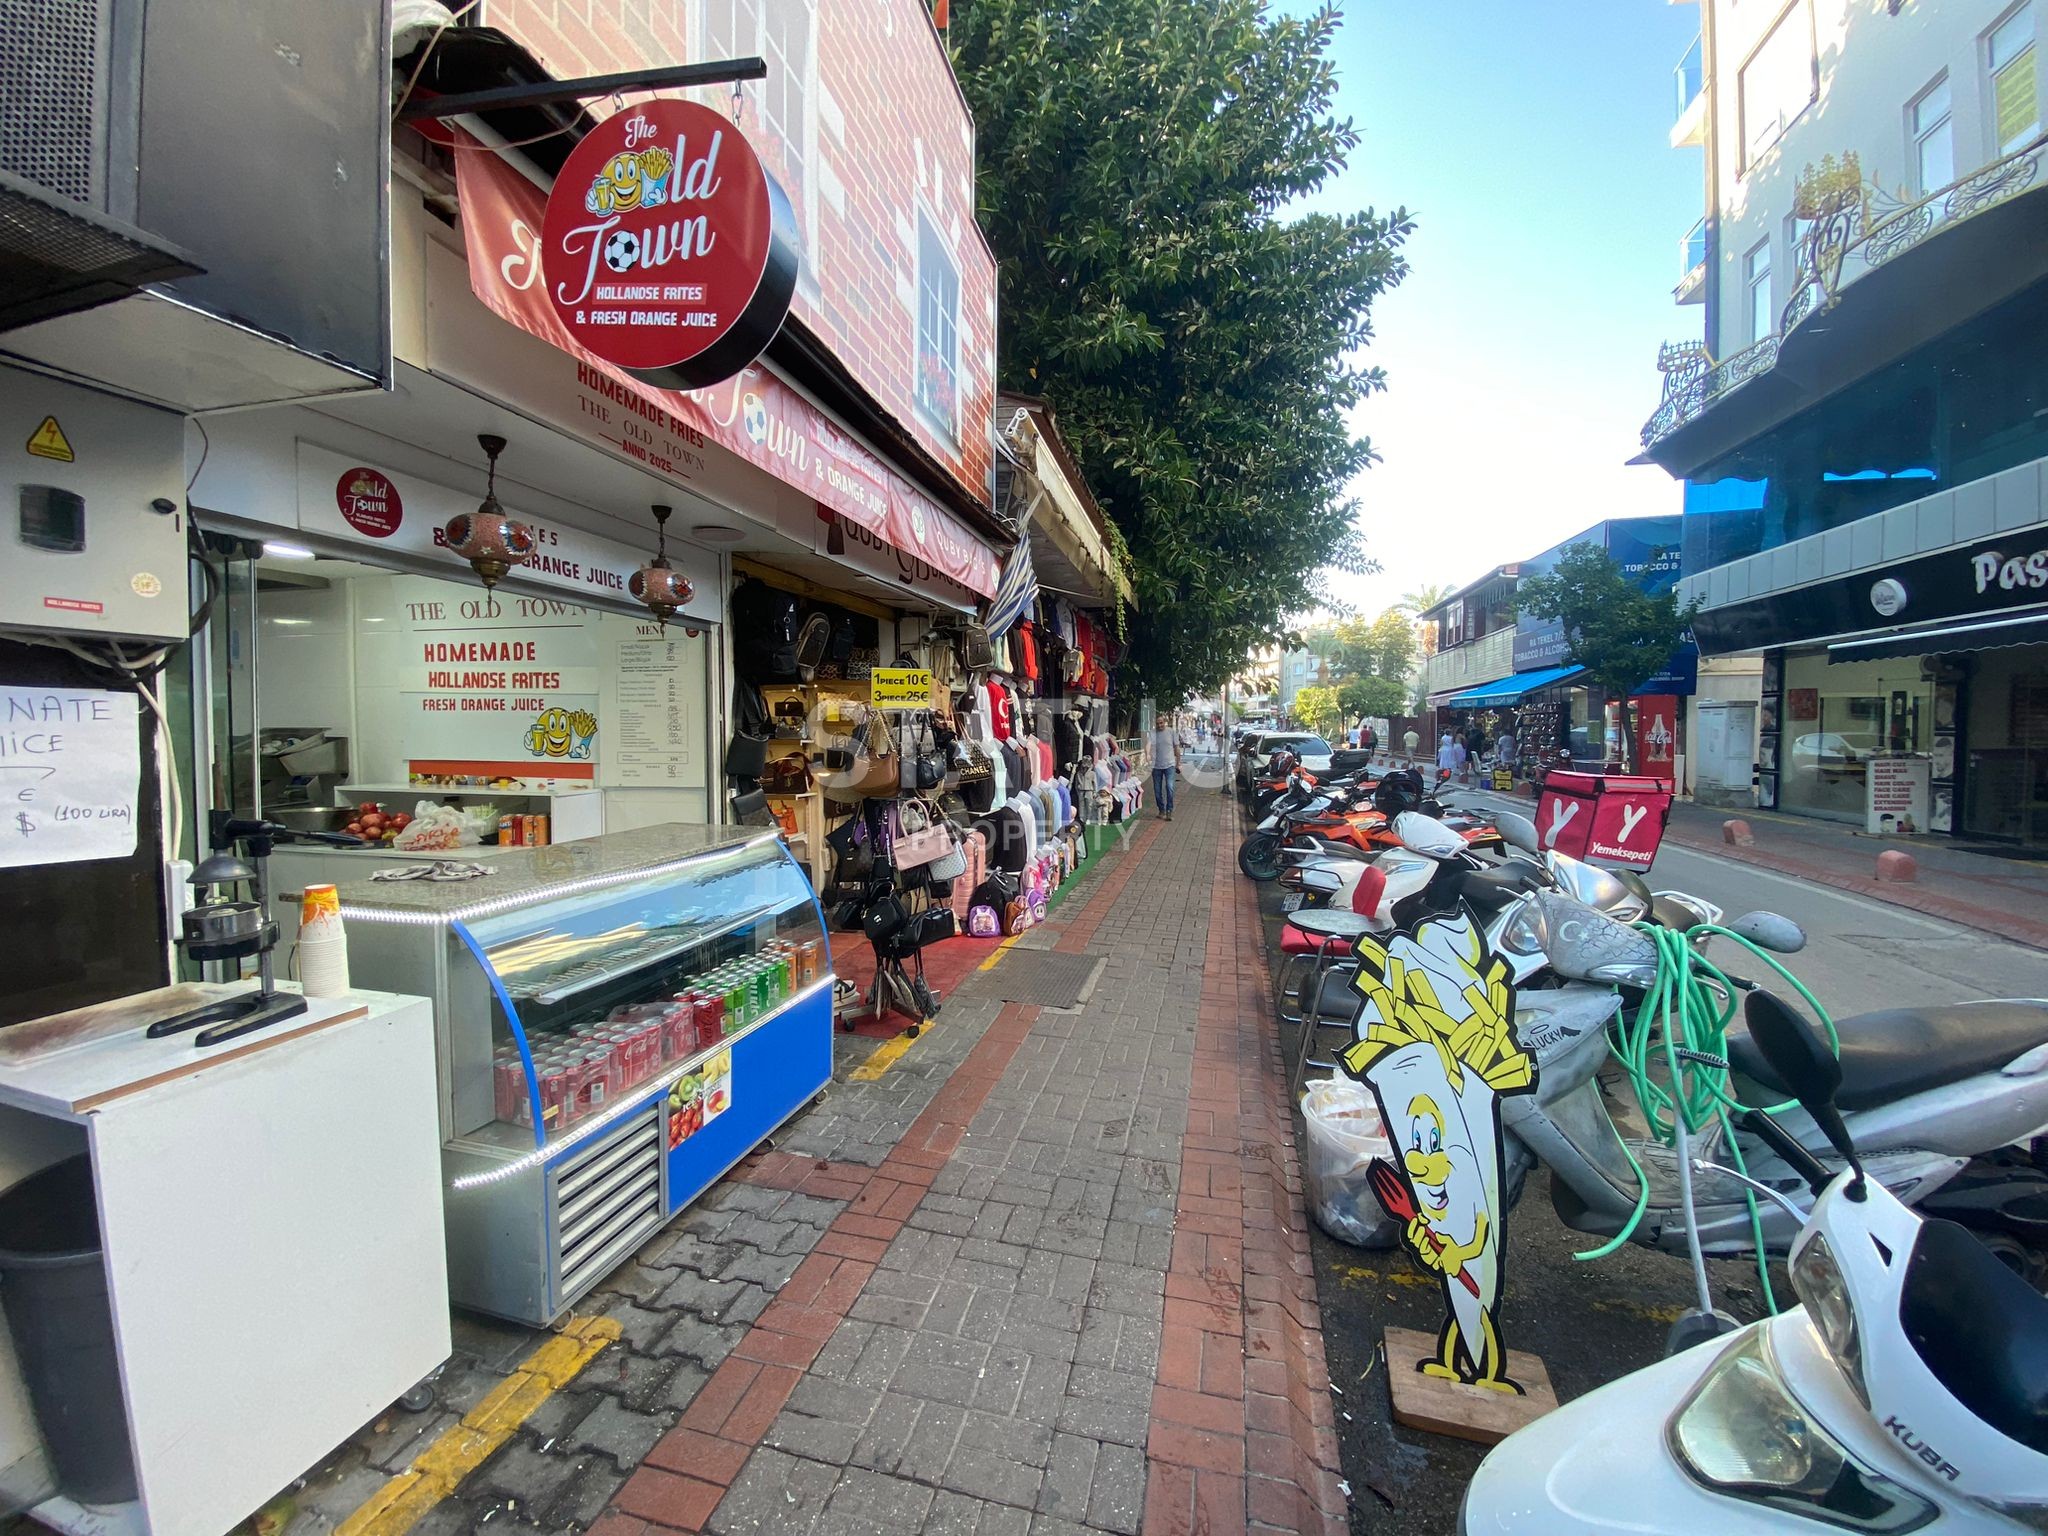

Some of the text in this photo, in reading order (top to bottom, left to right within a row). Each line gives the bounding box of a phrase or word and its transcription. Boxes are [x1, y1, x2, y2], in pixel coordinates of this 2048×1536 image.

[625, 115, 657, 148] The
[597, 285, 703, 300] HOLLANDSE FRITES
[576, 311, 717, 327] & FRESH ORANGE JUICE
[577, 362, 704, 449] HOMEMADE FRIES
[578, 394, 705, 471] THE OLD TOWN
[622, 439, 672, 473] ANNO 2025
[828, 466, 865, 505] ORANGE
[937, 531, 961, 559] QUBY
[587, 567, 623, 590] JUICE
[406, 597, 588, 620] THE OLD TOWN
[424, 641, 536, 662] HOMEMADE
[428, 672, 560, 689] HOLLANDSE FRITES
[8, 695, 113, 723] NATE
[423, 698, 545, 711] FRESH ORANGE JUICE
[960, 765, 990, 776] CHANEL
[16, 811, 36, 838] $
[1592, 842, 1652, 861] Yemeksepeti
[1530, 1028, 1564, 1051] LUCKY
[1884, 1415, 1961, 1481] KUBA
